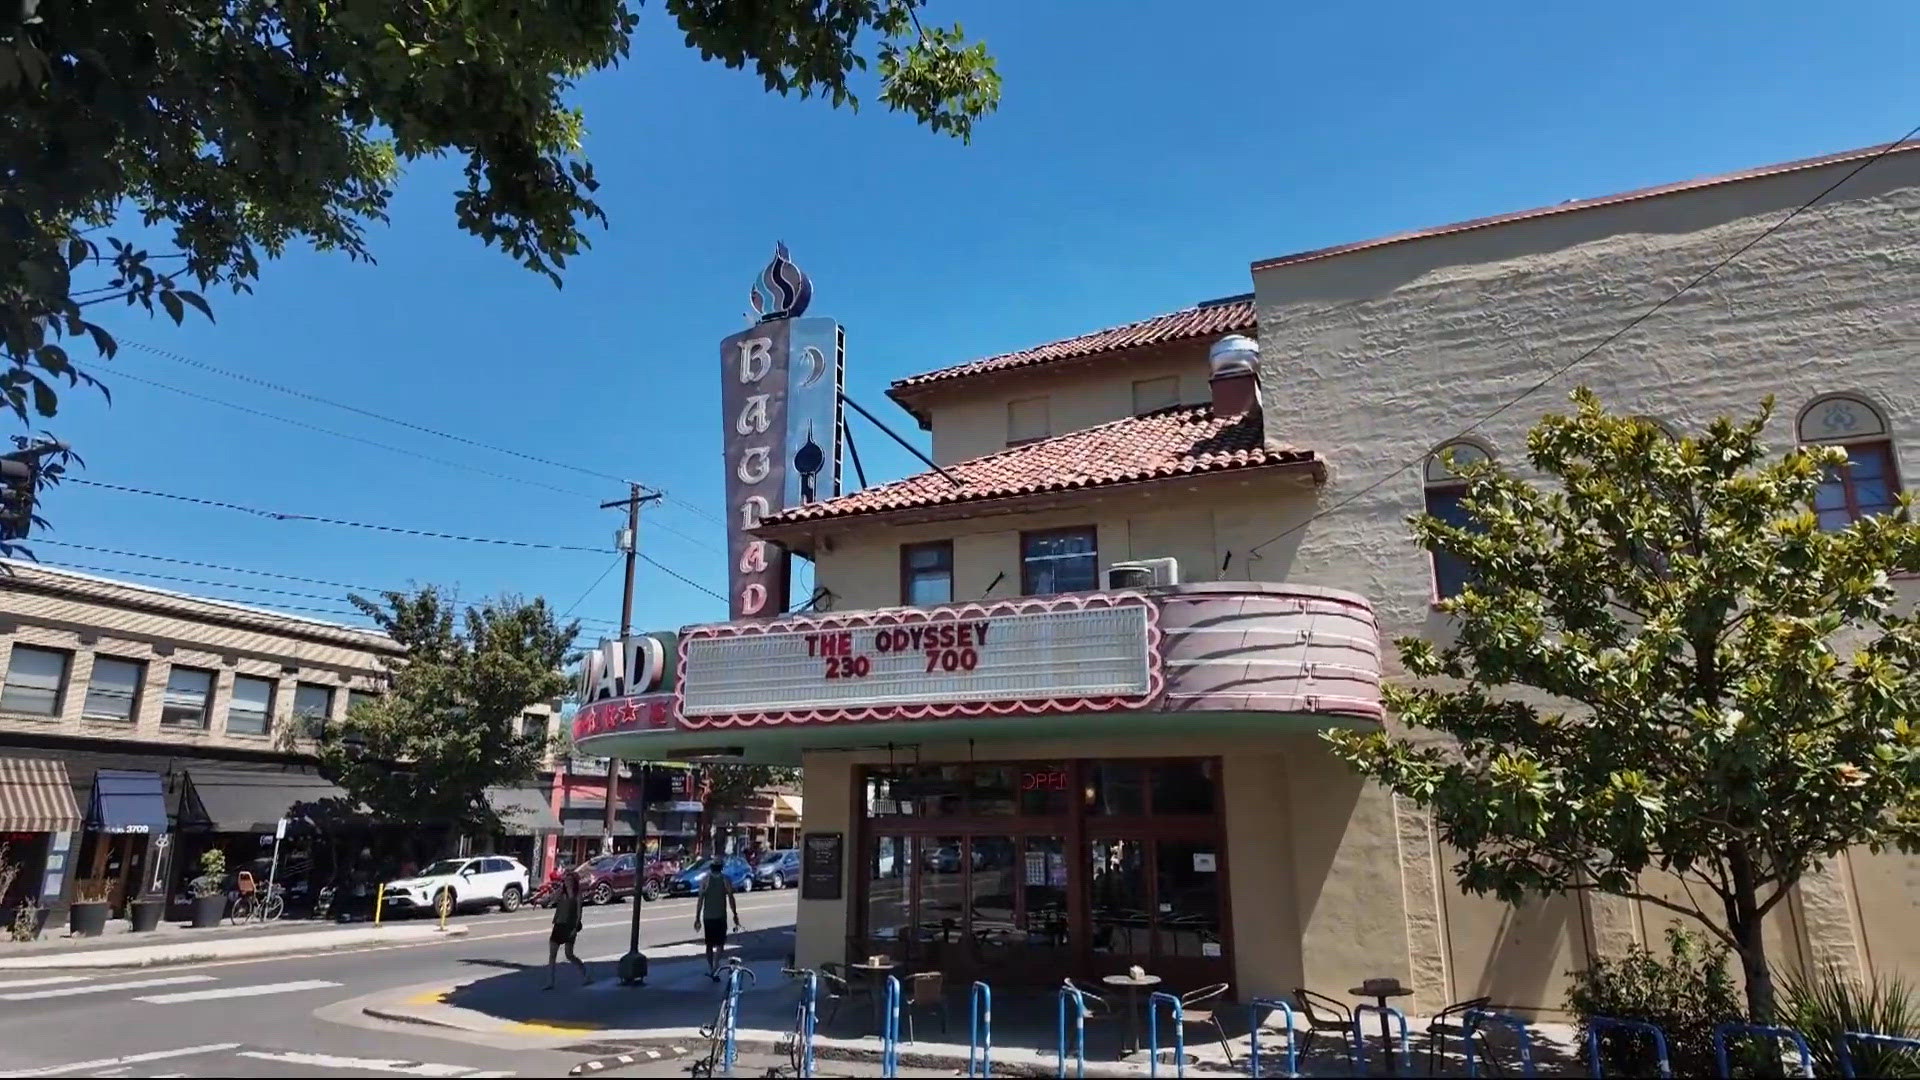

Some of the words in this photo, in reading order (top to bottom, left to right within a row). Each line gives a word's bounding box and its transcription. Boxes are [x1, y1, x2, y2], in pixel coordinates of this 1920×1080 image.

[736, 336, 773, 616] BAGDAD
[805, 631, 852, 657] THE
[875, 622, 990, 653] ODYSSEY
[825, 656, 870, 679] 230
[925, 648, 978, 673] 700
